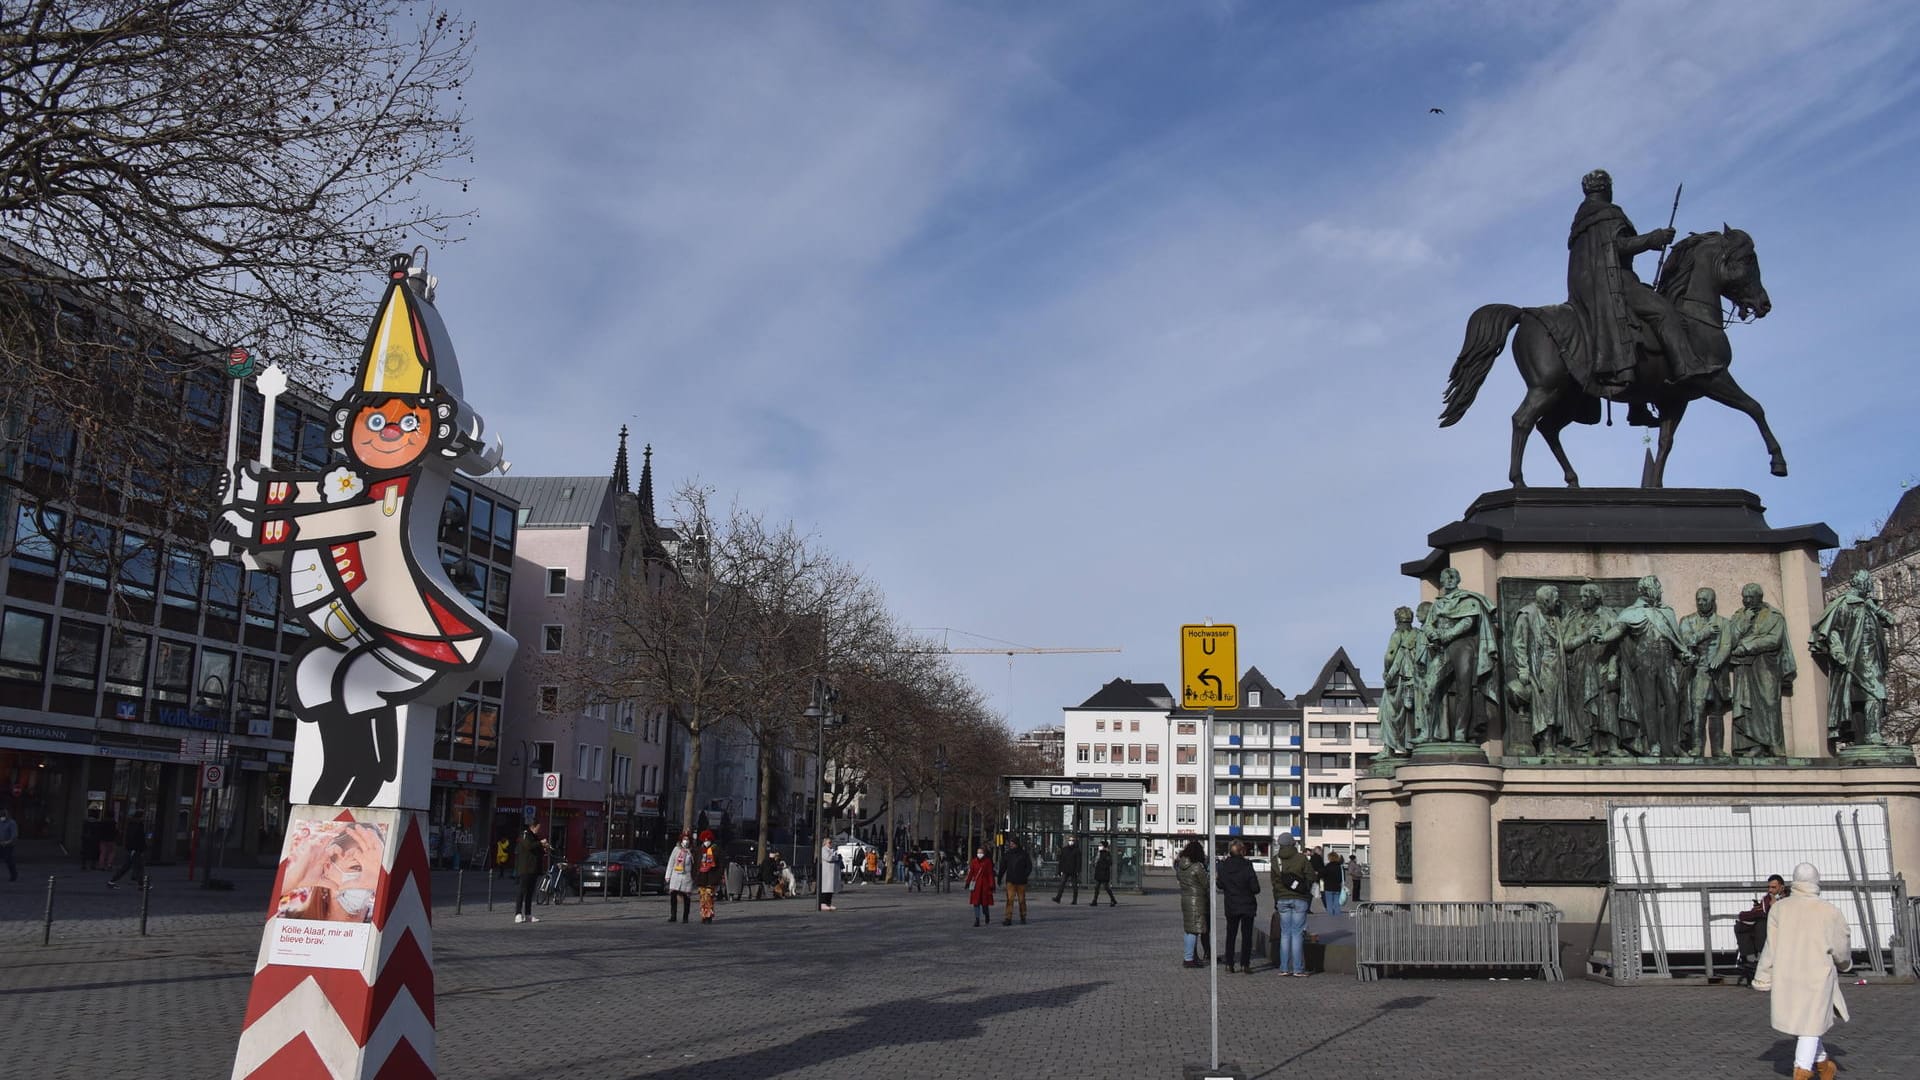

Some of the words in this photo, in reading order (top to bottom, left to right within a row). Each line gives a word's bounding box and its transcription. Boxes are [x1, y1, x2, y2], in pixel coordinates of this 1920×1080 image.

[1188, 630, 1229, 638] Hochwasser
[1203, 638, 1215, 655] U
[1224, 693, 1234, 701] für
[210, 770, 218, 778] 20
[548, 779, 555, 787] 20
[304, 926, 326, 936] Alaaf,
[329, 929, 342, 937] mir
[344, 929, 354, 937] all
[280, 934, 303, 943] blieve
[306, 936, 325, 944] brav.
